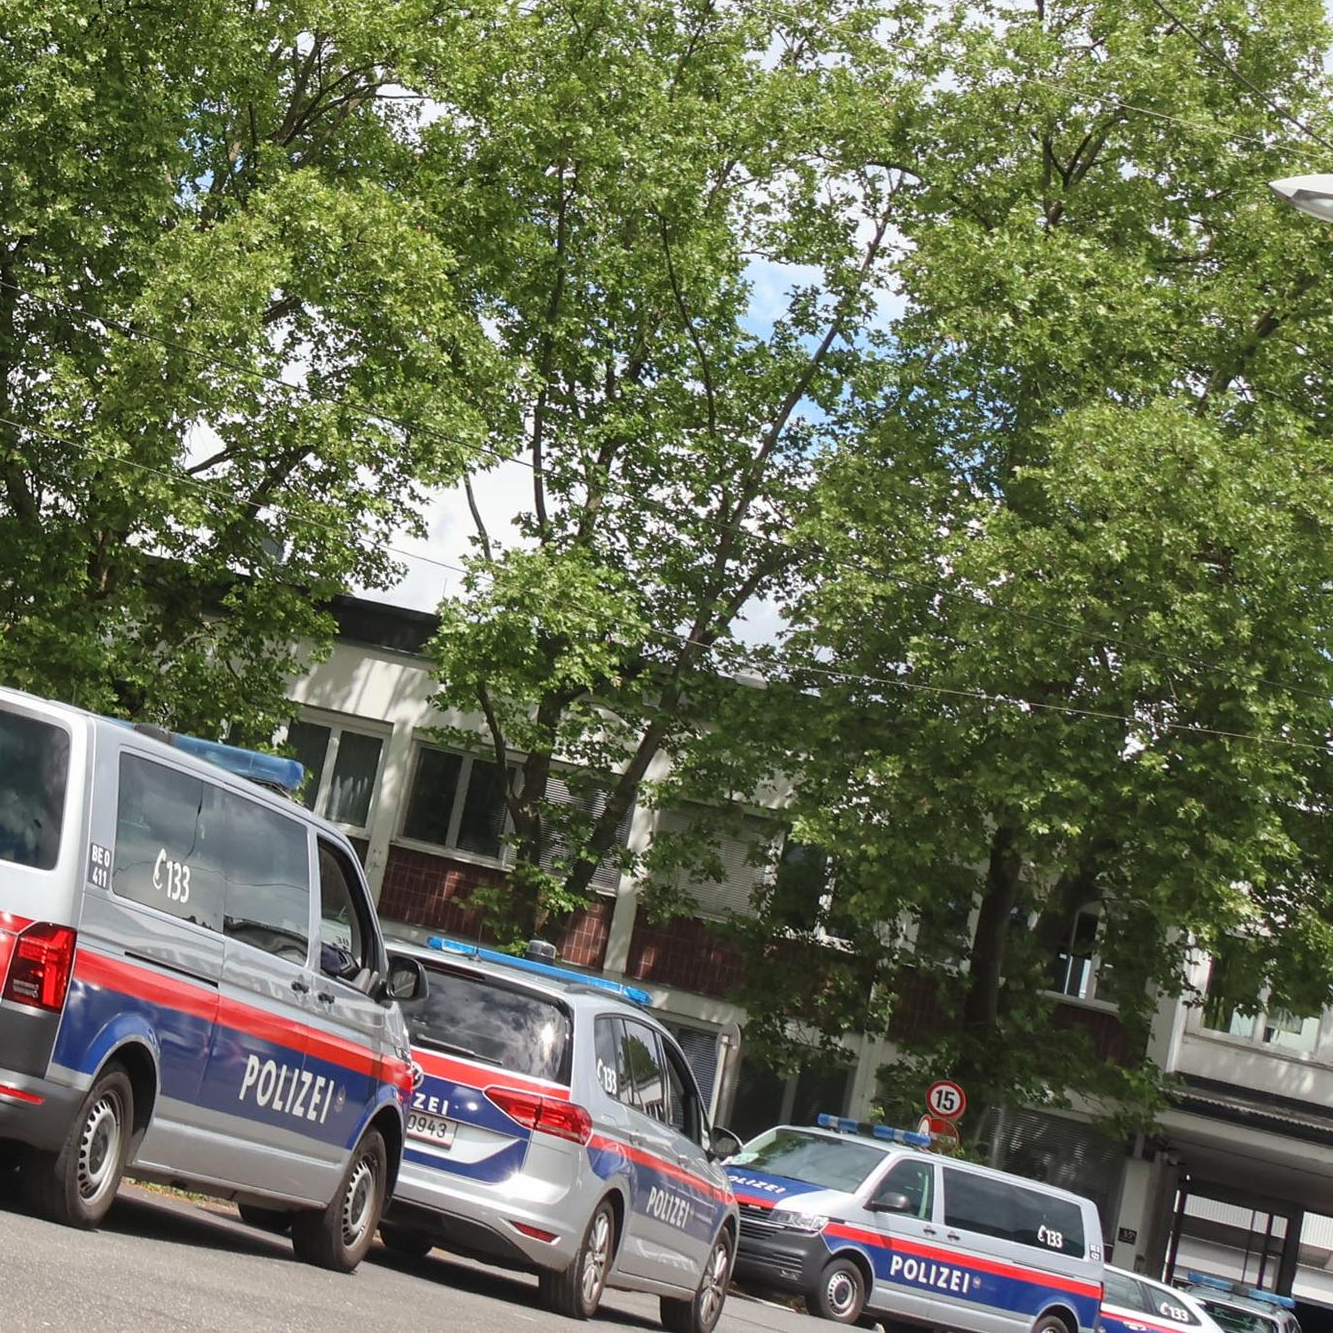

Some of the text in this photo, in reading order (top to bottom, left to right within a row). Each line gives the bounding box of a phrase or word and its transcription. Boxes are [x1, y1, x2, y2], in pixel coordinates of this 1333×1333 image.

[91, 844, 104, 865] BE
[92, 866, 108, 888] 411
[166, 860, 191, 903] 133
[238, 1054, 335, 1124] POLIZEI
[603, 1066, 617, 1095] 133
[413, 1092, 449, 1116] ZEI
[936, 1089, 955, 1111] 15
[406, 1114, 448, 1138] 0943
[728, 1175, 786, 1194] OLIZEI
[645, 1186, 690, 1229] POLIZEI
[1046, 1229, 1063, 1248] 133
[890, 1254, 970, 1294] POLIZEI
[1169, 1306, 1189, 1322] 133
